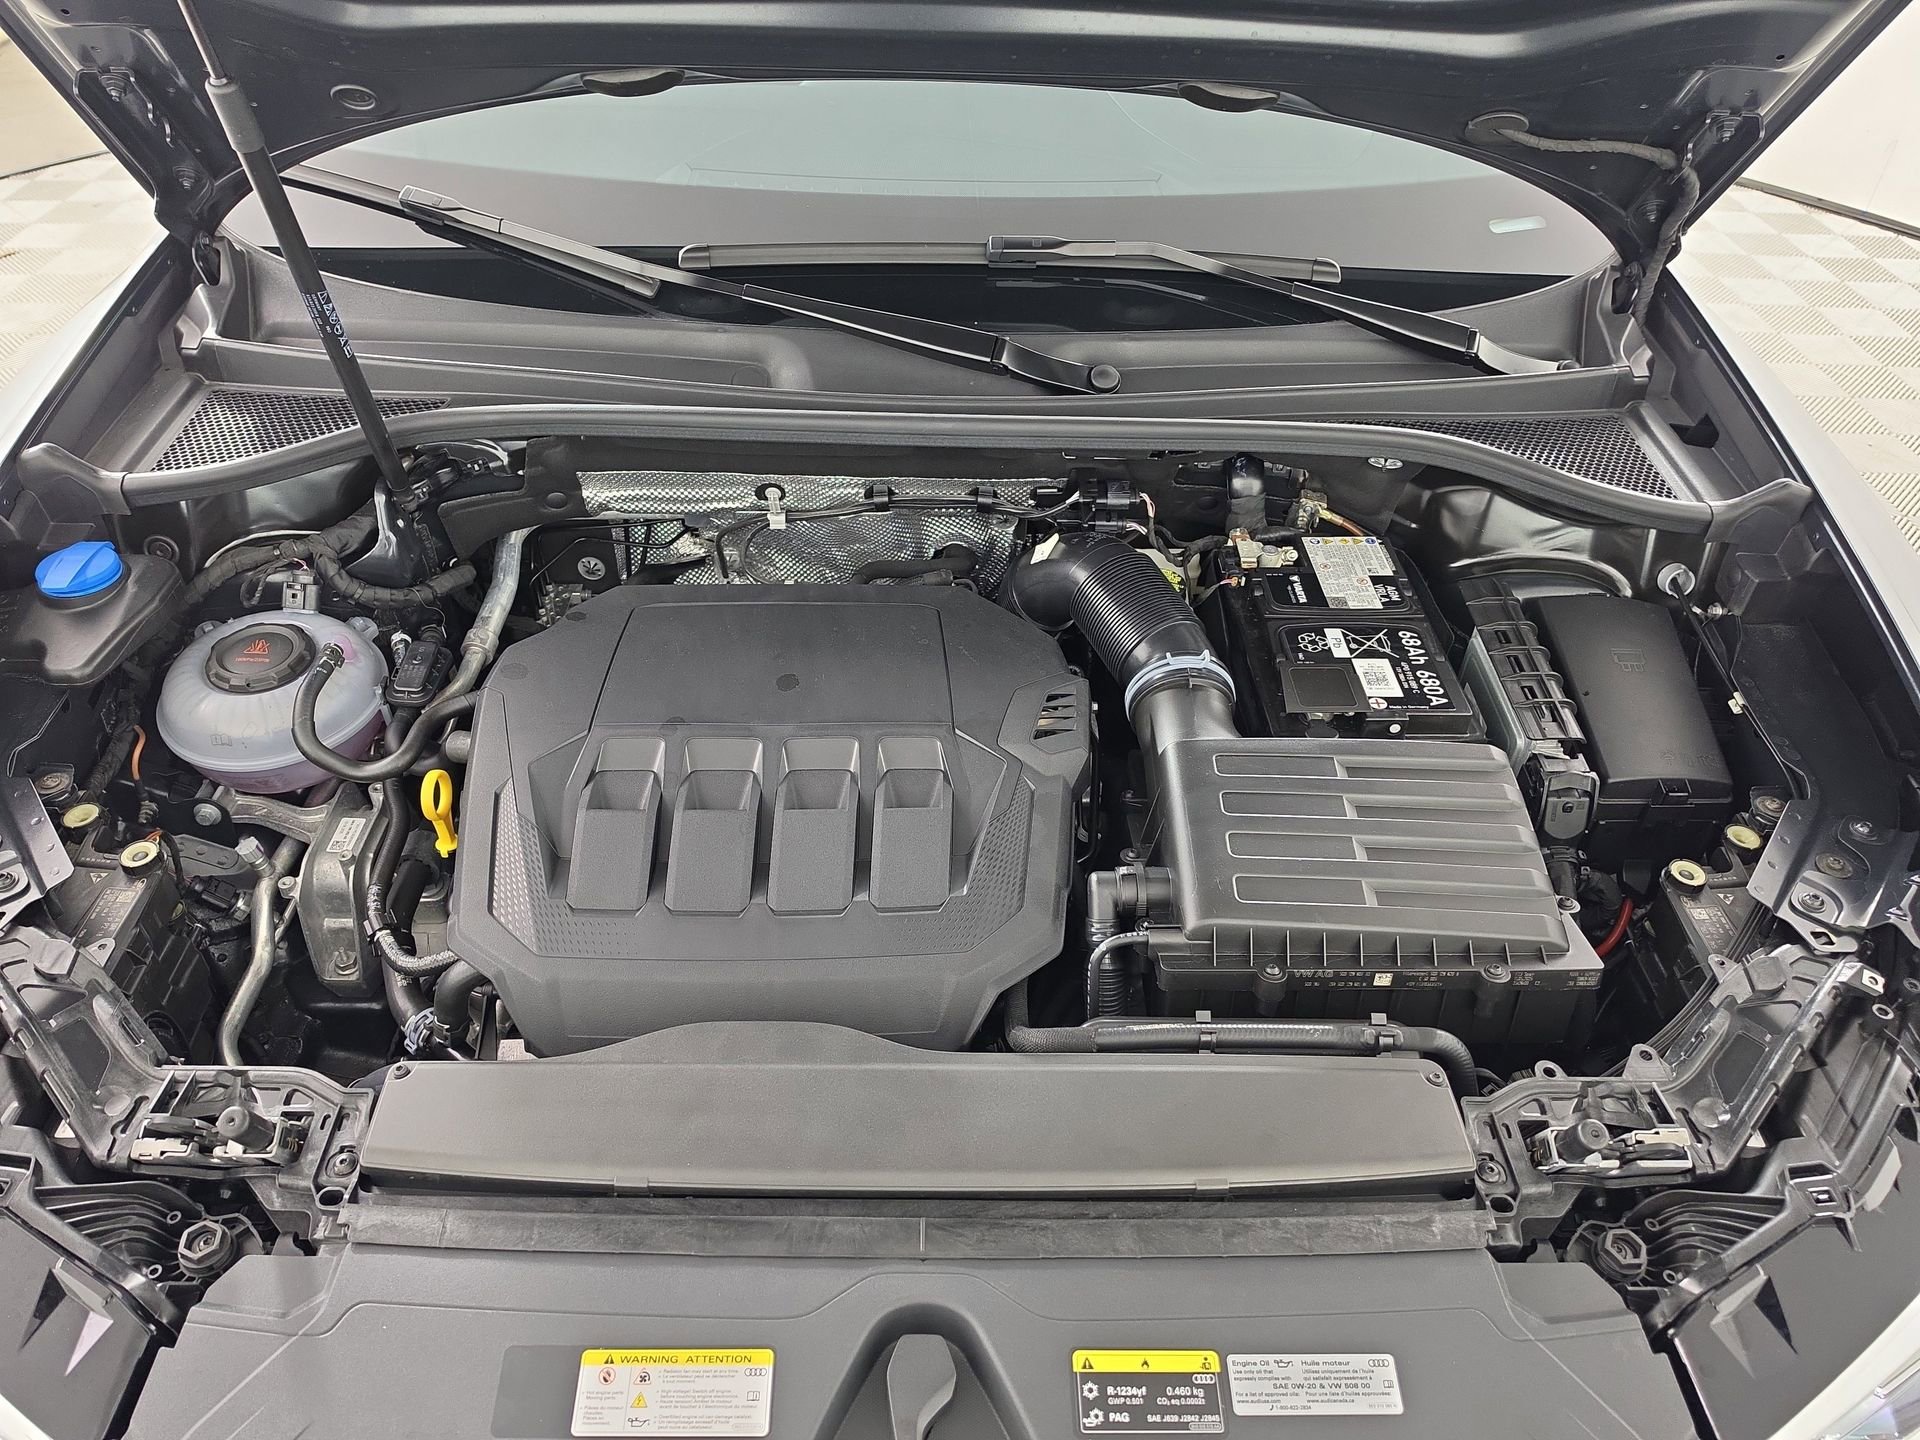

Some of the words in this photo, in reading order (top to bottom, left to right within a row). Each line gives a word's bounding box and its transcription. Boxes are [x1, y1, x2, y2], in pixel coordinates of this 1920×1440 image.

[1293, 582, 1308, 603] VARTA
[1374, 584, 1390, 603] VRLA
[1385, 585, 1402, 601] AGM
[1331, 638, 1342, 648] Pb
[1398, 630, 1428, 664] 68Ah
[1416, 670, 1449, 706] 680A
[620, 1355, 678, 1364] WARNING
[685, 1355, 752, 1364] ATTENTION
[1107, 1386, 1147, 1397] R-1234yf
[1166, 1386, 1191, 1396] 0.460
[1192, 1386, 1204, 1397] kg
[1108, 1397, 1125, 1405] GWP
[1109, 1412, 1130, 1422] PAG
[1147, 1414, 1161, 1422] SAE
